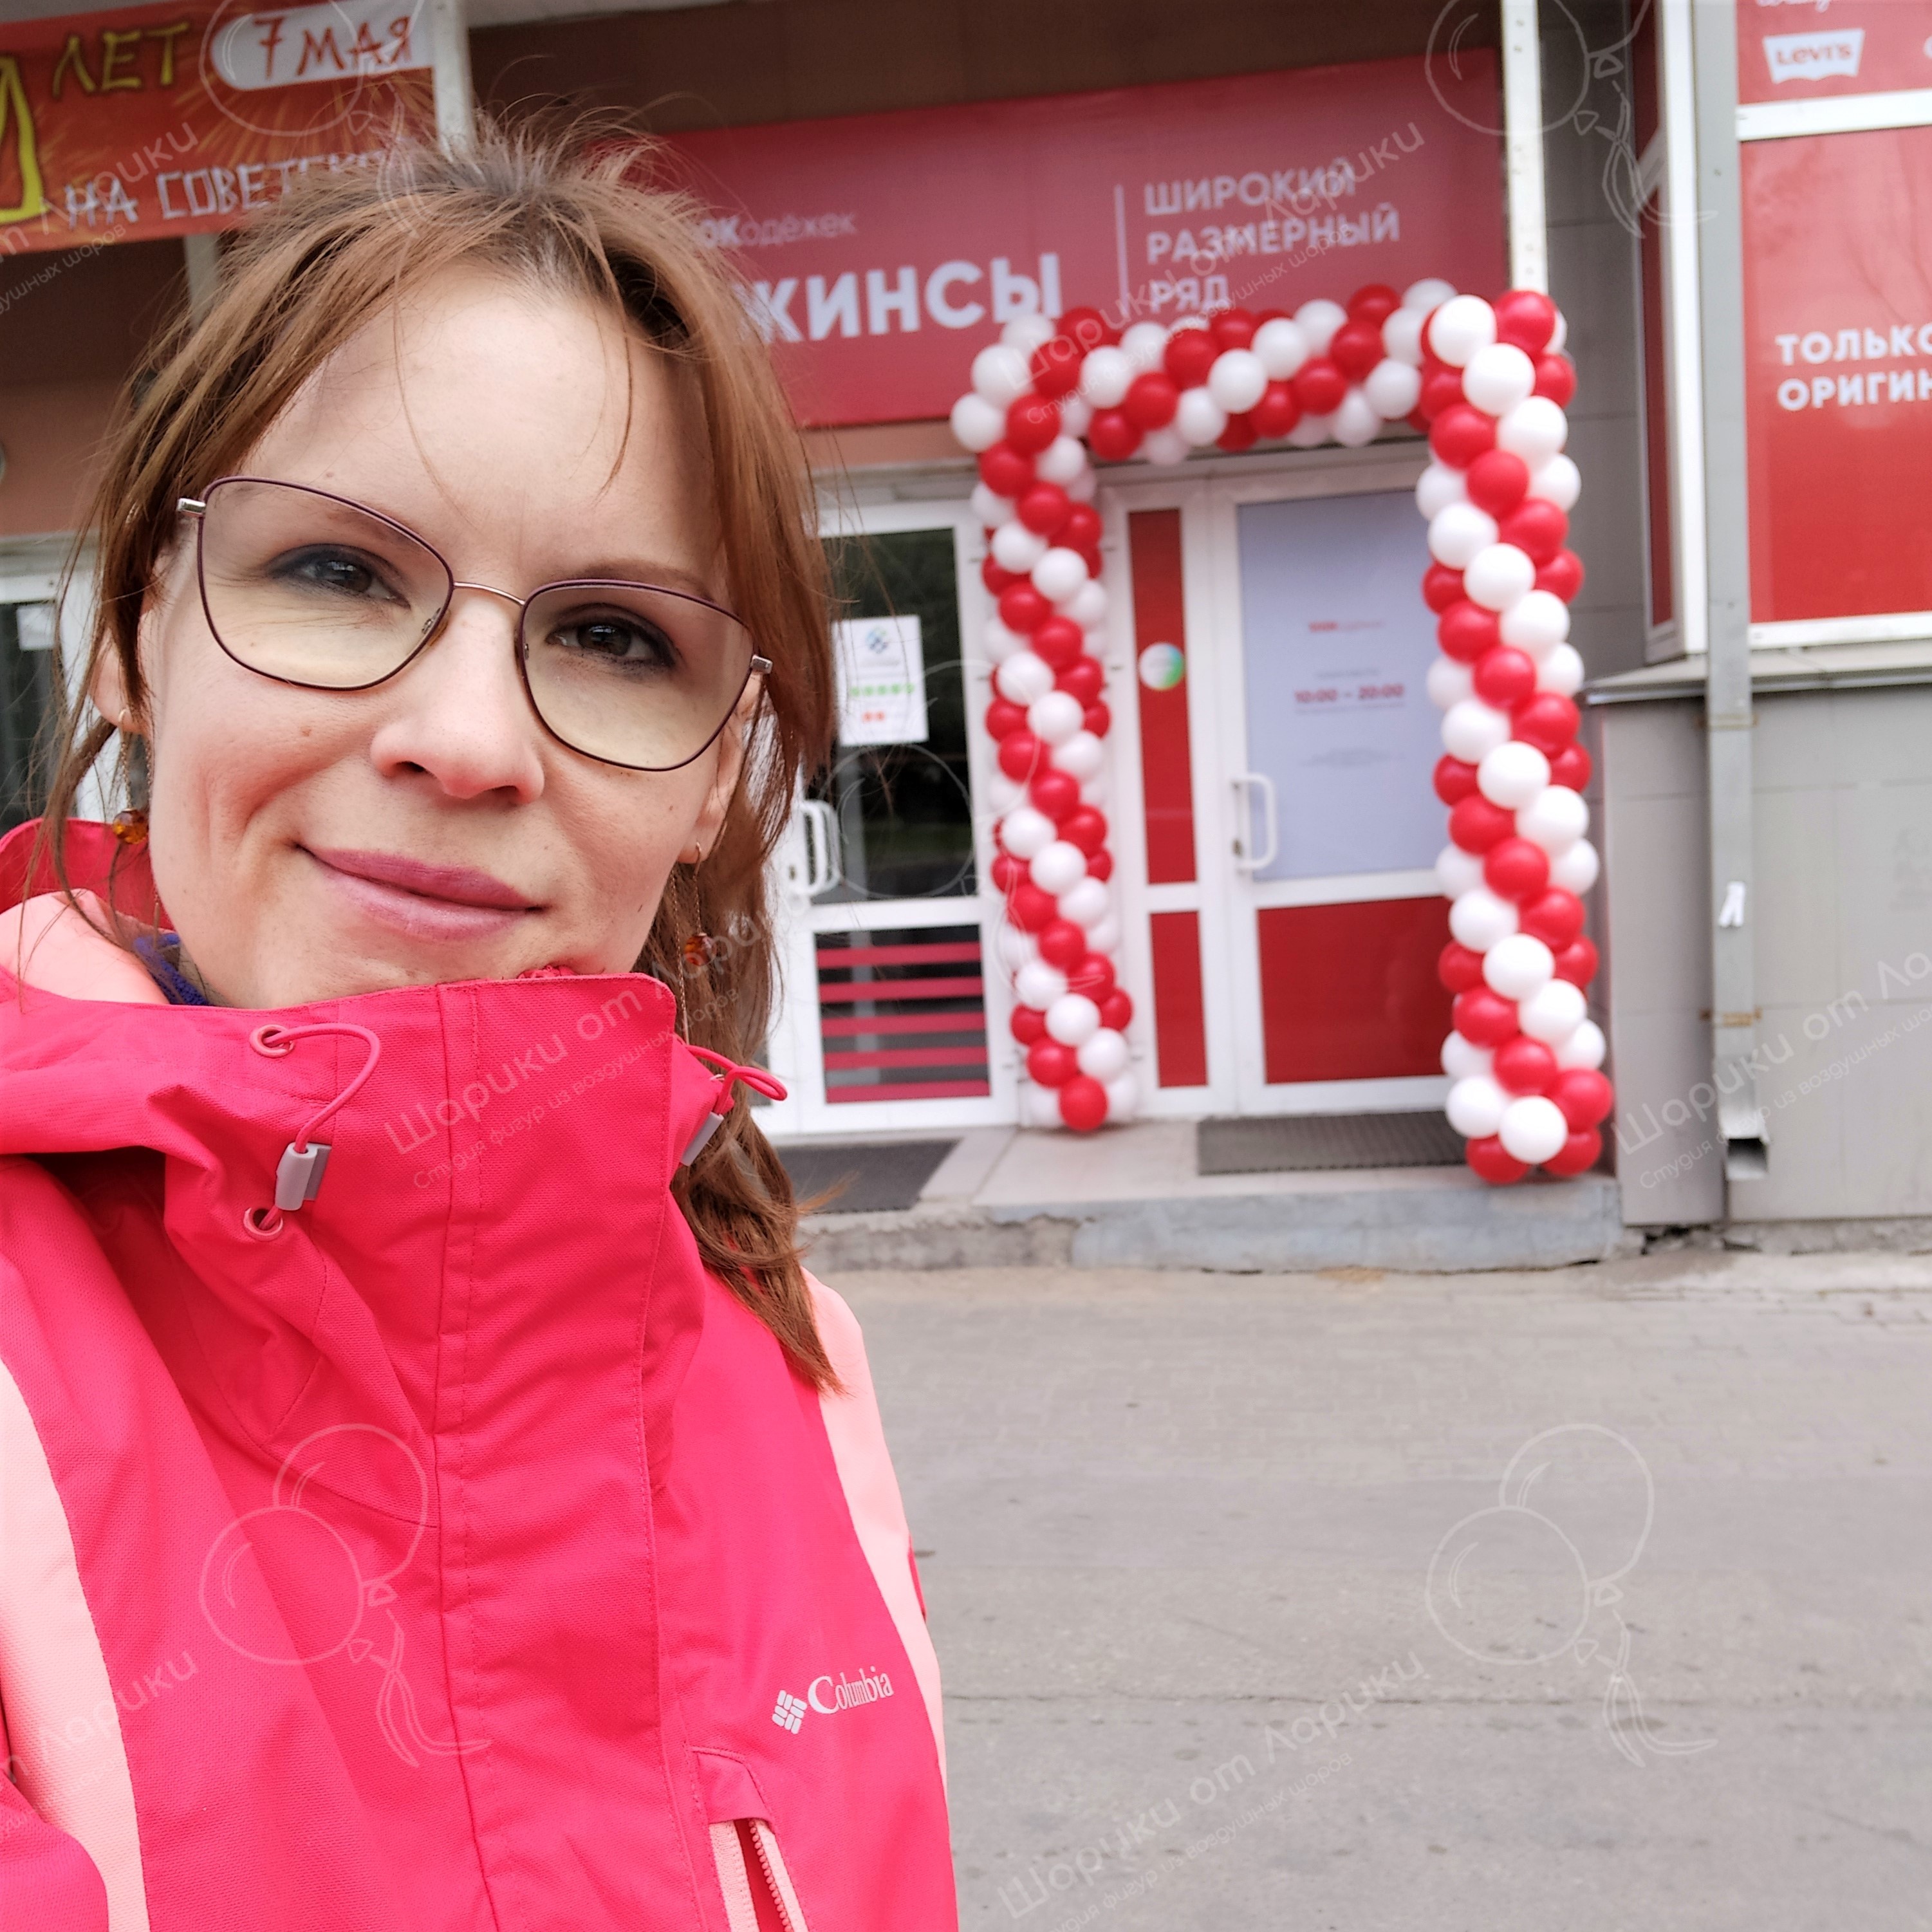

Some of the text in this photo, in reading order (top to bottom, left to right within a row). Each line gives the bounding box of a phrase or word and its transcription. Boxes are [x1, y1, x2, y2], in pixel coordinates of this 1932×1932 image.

[52, 21, 189, 98] ЛЕТ
[257, 15, 414, 79] 7 МАЯ
[65, 178, 138, 228] НА
[1144, 156, 1356, 216] ШИРОКИЙ
[1147, 201, 1401, 264] РАЗМЕРНЫЙ
[732, 252, 1062, 345] ЖИНСЫ
[1149, 274, 1229, 313] РЯД
[807, 1665, 895, 1714] Columbia
